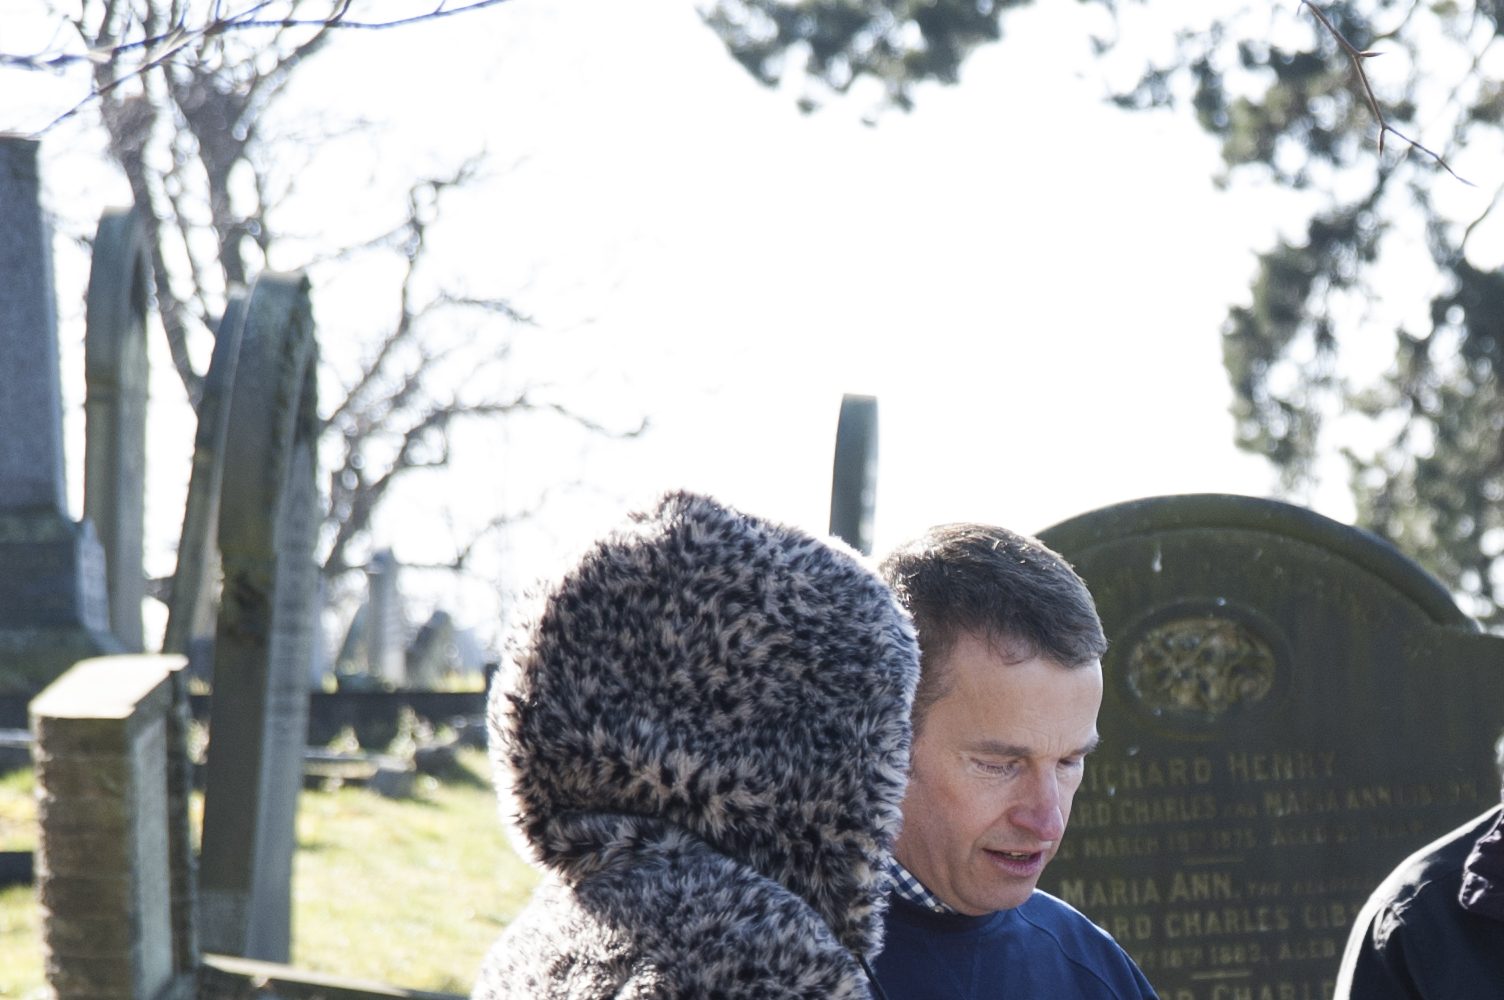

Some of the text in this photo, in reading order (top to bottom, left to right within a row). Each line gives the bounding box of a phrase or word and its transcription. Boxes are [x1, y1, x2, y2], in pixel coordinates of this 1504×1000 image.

[1228, 750, 1336, 784] HENRY
[1119, 793, 1218, 826] CHARLES
[1346, 783, 1392, 810] ANN
[1082, 835, 1160, 858] MARCH
[1060, 876, 1160, 908] MARIA
[1164, 902, 1290, 939] CHARLES
[1278, 937, 1337, 962] AGED
